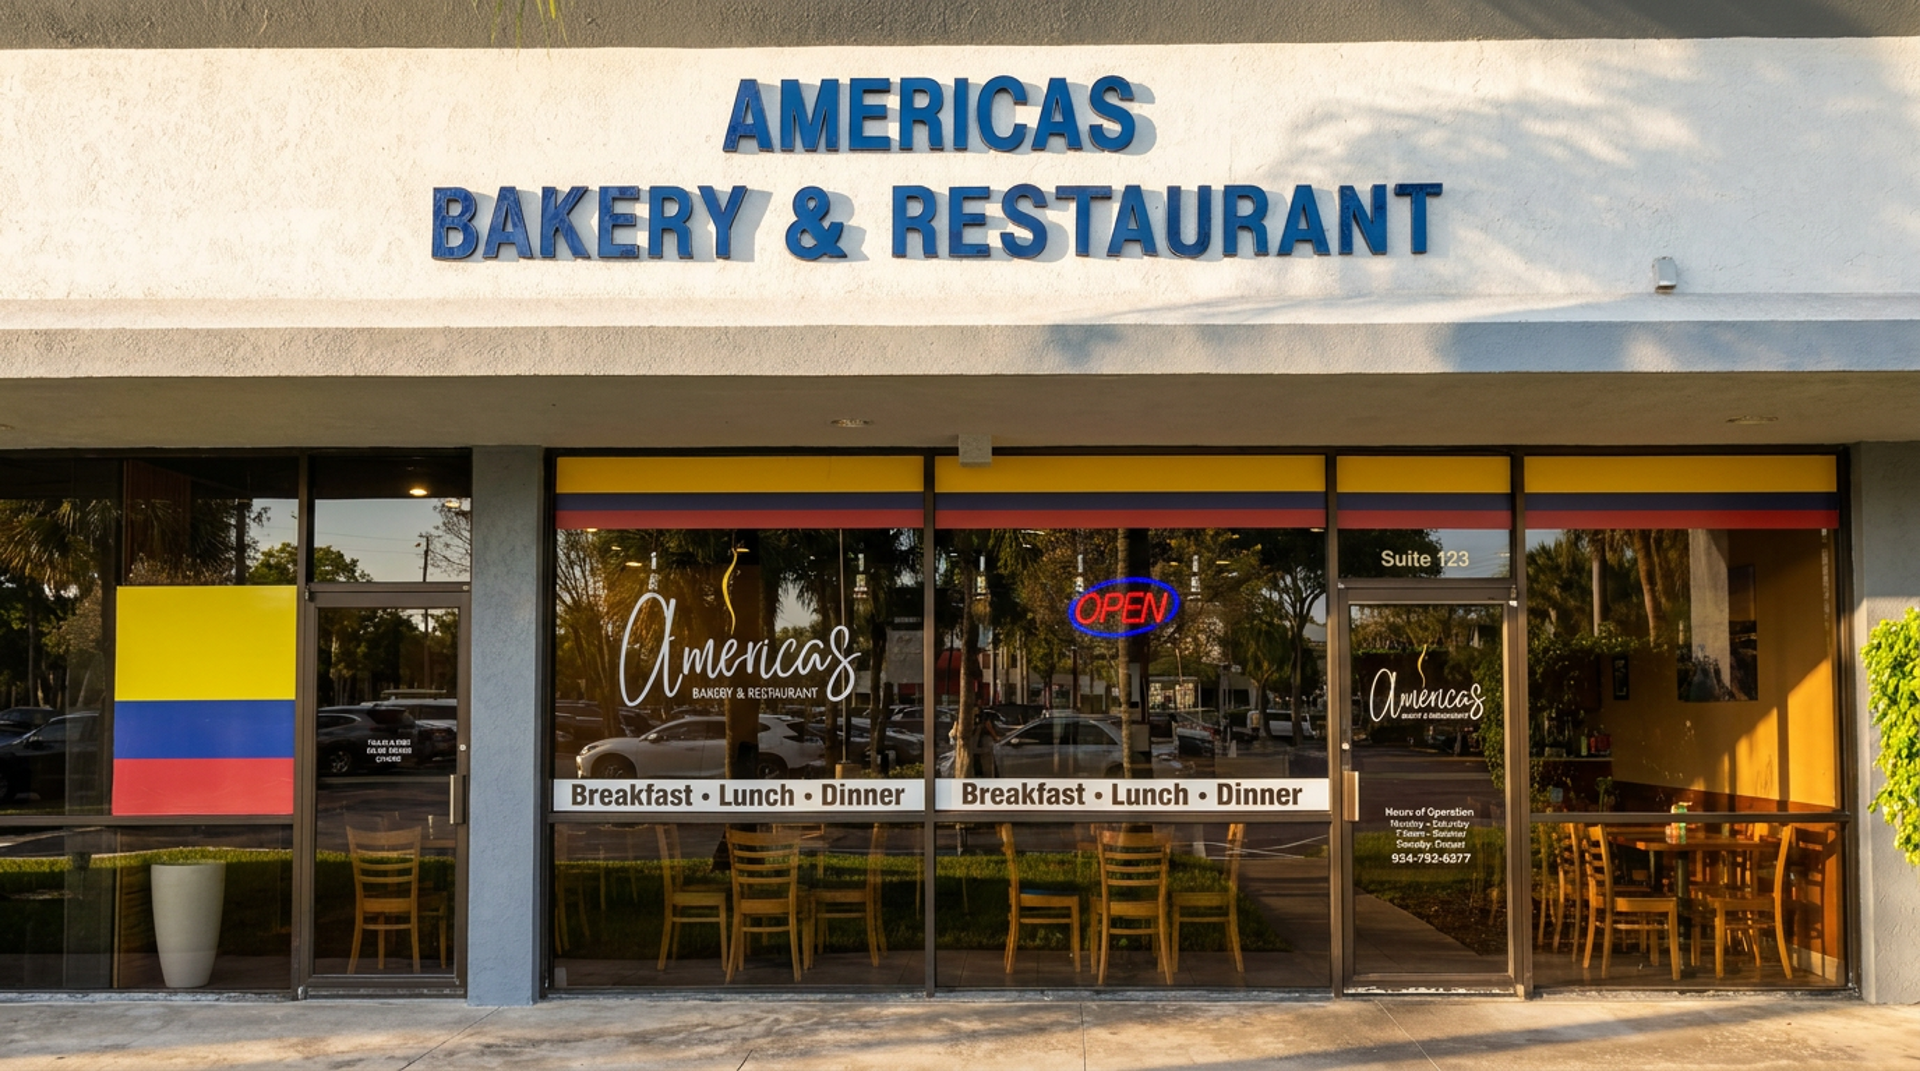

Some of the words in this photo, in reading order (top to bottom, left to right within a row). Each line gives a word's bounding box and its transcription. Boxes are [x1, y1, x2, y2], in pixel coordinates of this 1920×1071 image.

[723, 76, 1137, 152] AMERICAS
[432, 185, 748, 260] BAKERY
[786, 186, 847, 259] &
[892, 183, 1443, 257] RESTAURANT
[1381, 549, 1432, 567] Suite
[1438, 550, 1470, 567] 123
[1075, 590, 1168, 625] OPEN
[619, 592, 861, 707] Americas
[736, 687, 745, 699] &
[571, 783, 693, 806] Breakfast
[719, 783, 795, 806] Lunch
[821, 783, 905, 806] Dinner
[962, 782, 1086, 805] Breakfast
[1112, 782, 1189, 805] Lunch
[1217, 782, 1303, 805] Dinner
[1415, 807, 1425, 817] of
